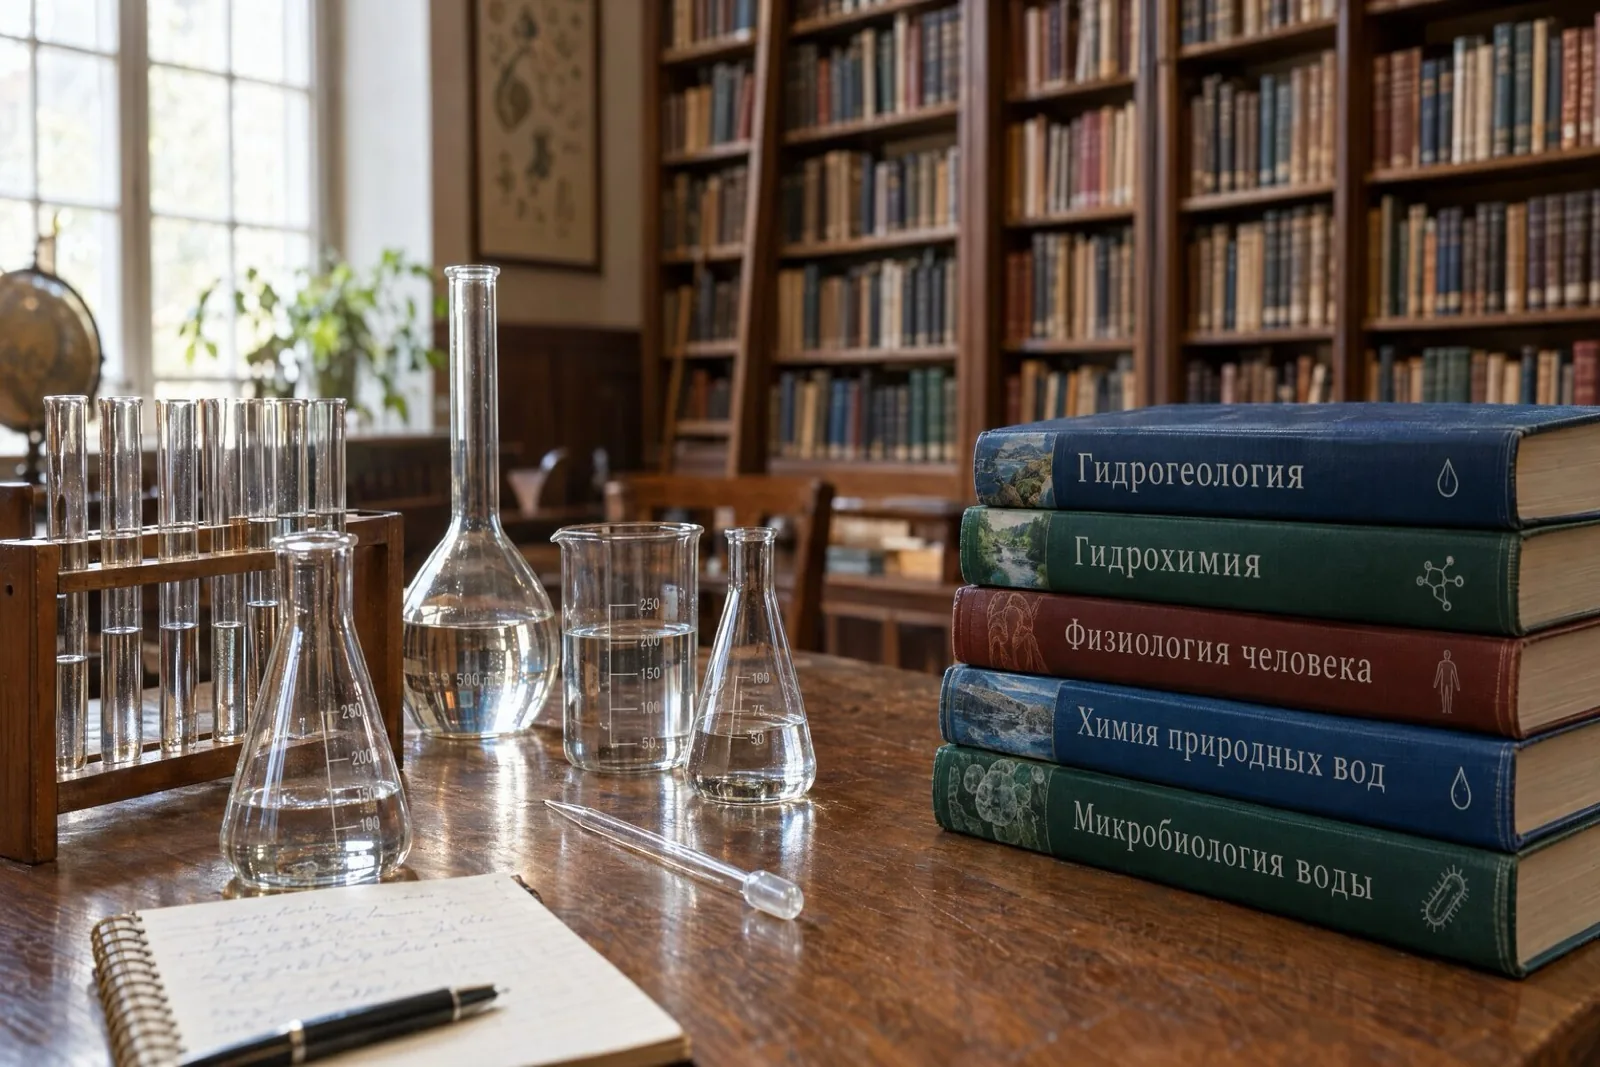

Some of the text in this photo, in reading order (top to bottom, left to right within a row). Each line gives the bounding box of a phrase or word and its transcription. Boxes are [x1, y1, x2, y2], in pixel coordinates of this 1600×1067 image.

[1078, 452, 1304, 493] Гидрогеология
[1075, 535, 1261, 579] Гидрохимия
[640, 597, 660, 611] 250
[640, 634, 660, 648] 200
[1065, 618, 1373, 684] Физиология человека
[456, 672, 480, 687] 500
[640, 667, 661, 680] 150
[751, 672, 770, 685] 100
[341, 702, 362, 719] 250
[640, 701, 660, 714] 100
[752, 704, 765, 717] 75
[750, 733, 765, 745] 50
[351, 748, 373, 766] 200
[1078, 706, 1386, 793] Химия природных вод
[360, 816, 380, 832] 100
[1073, 800, 1373, 900] Микробиология воды
